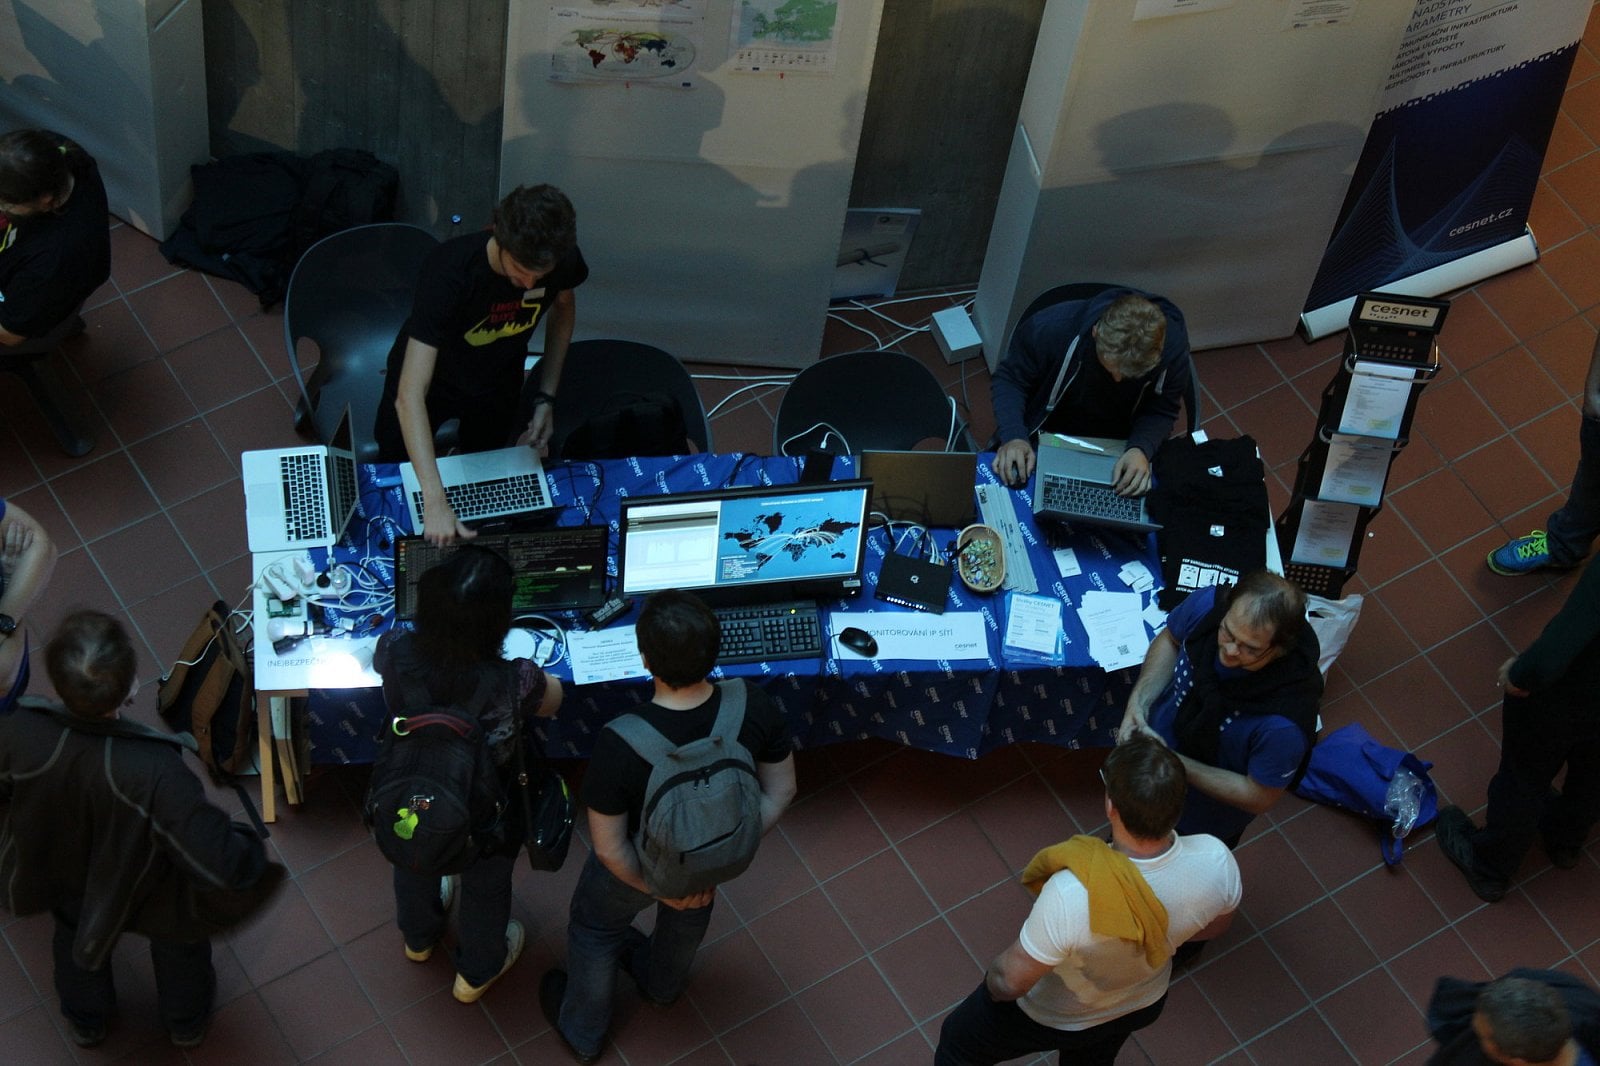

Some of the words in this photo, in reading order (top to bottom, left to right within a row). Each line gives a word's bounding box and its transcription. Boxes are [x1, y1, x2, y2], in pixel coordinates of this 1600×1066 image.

[1406, 4, 1472, 32] ARAMETRY
[1399, 26, 1449, 50] OMUNIKAČNÍ
[1396, 46, 1420, 59] ATOVÁ
[1448, 208, 1513, 237] cesnet.cz
[1370, 304, 1430, 319] cesnet
[1019, 521, 1038, 546] cesnet
[1055, 581, 1073, 607] cesnet
[981, 606, 998, 632] cesnet
[867, 628, 928, 637] ONITOROVÁNÍ
[929, 629, 937, 637] IP
